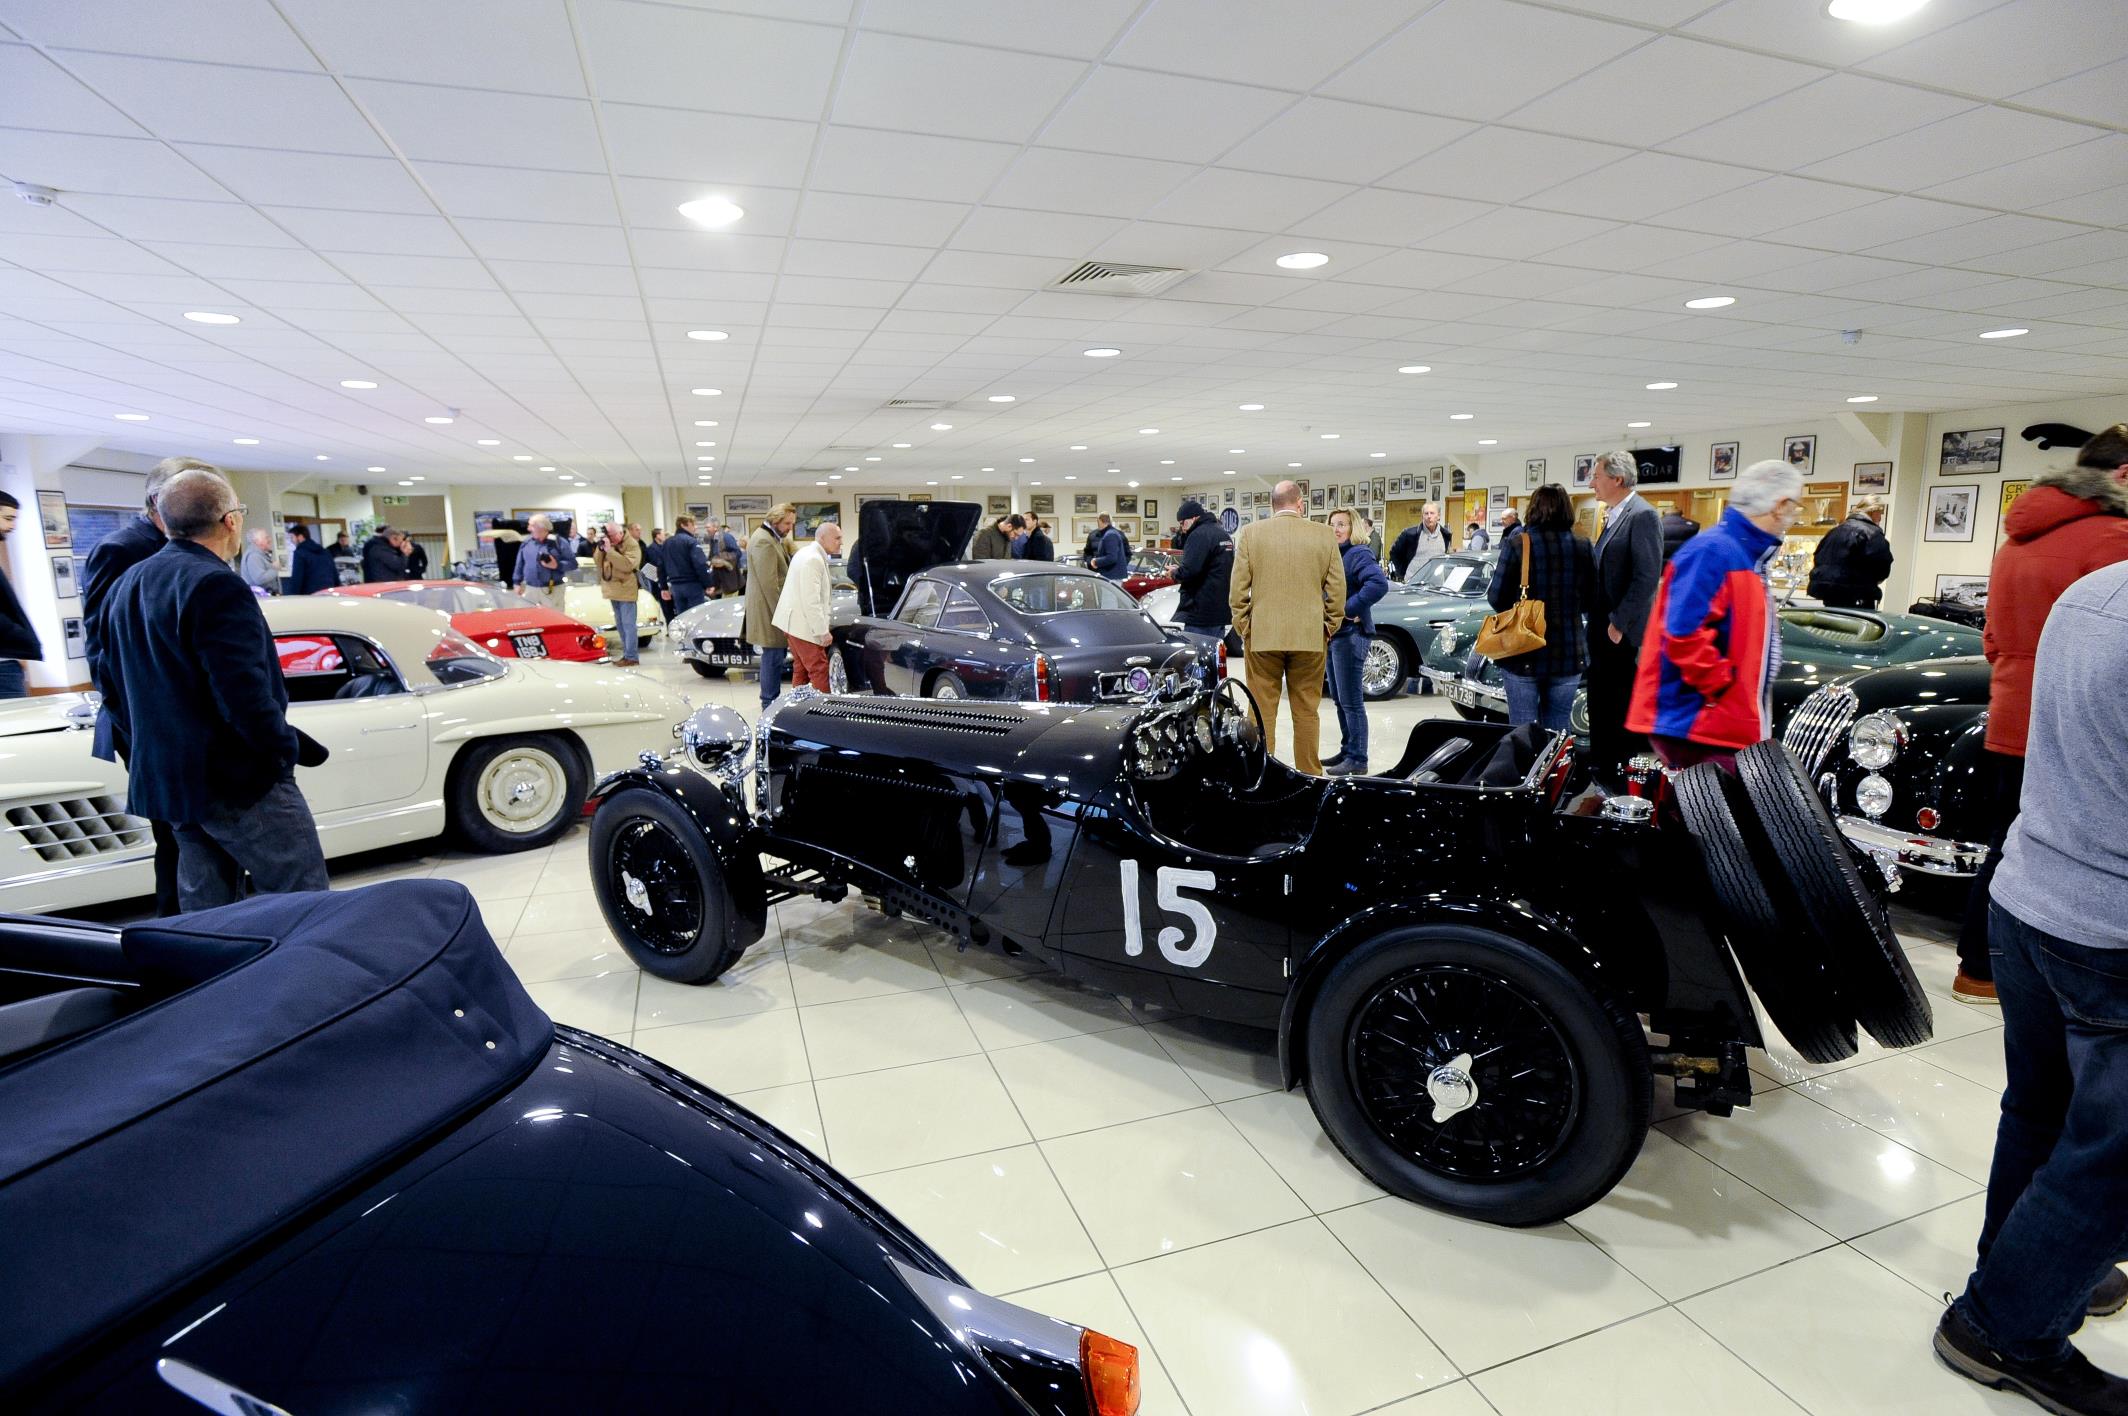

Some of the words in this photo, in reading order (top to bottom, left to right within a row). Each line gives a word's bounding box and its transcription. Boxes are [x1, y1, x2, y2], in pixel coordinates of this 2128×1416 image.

[1638, 465, 1673, 477] GUAR
[2006, 484, 2027, 494] CR
[1444, 683, 1458, 700] FEA
[1120, 859, 1217, 968] 15
